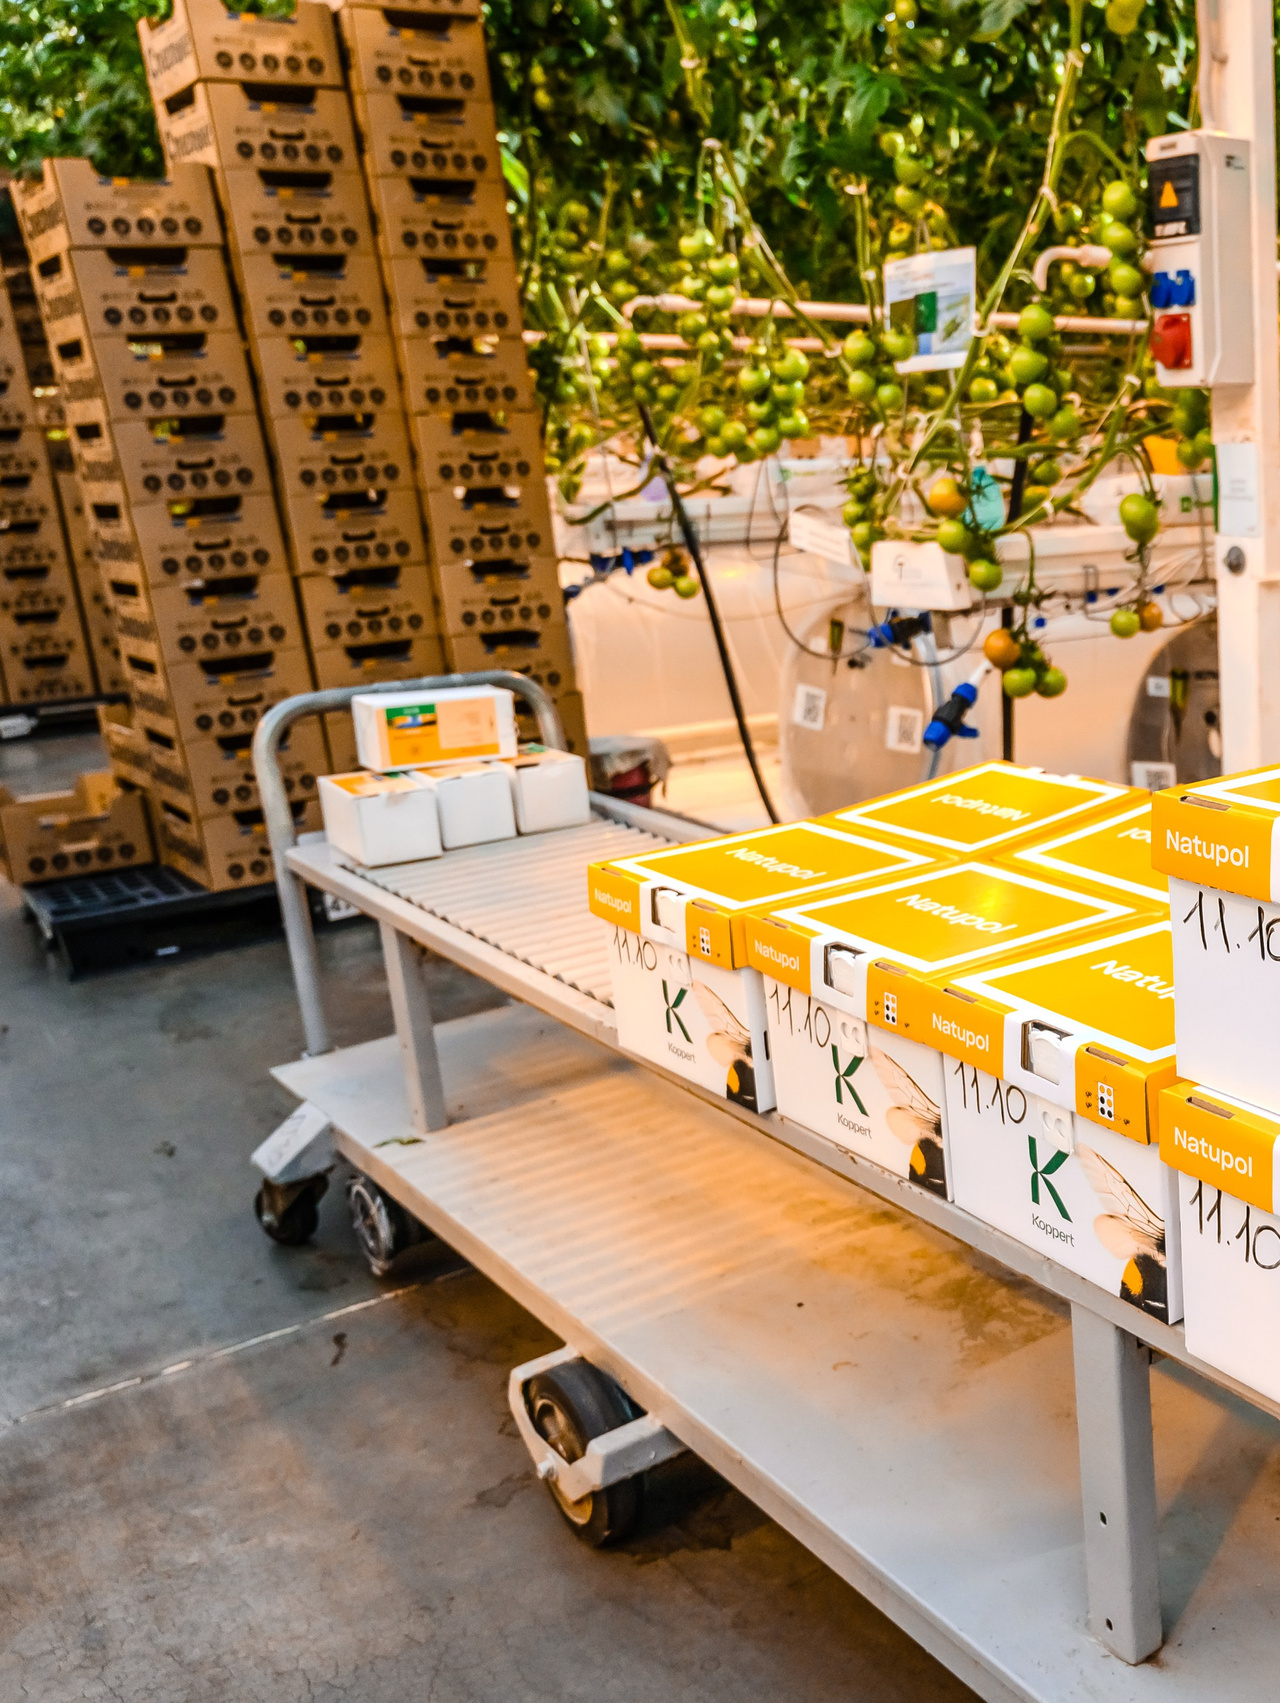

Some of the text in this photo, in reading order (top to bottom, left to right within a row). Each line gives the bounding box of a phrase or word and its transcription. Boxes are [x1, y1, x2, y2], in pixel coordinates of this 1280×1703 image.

[930, 792, 1032, 822] Natupol
[725, 846, 828, 880] Natupol
[1166, 828, 1250, 869] Natupol
[594, 887, 633, 915] Natupol
[896, 893, 1018, 935] Natupol
[613, 925, 659, 972] 11.10
[754, 938, 801, 972] Natupol
[768, 983, 833, 1049] 11.10
[932, 1012, 990, 1053] Natupol
[953, 1062, 1029, 1125] 11.10
[836, 1111, 874, 1140] Koppert
[1174, 1126, 1254, 1178] Natupol
[1031, 1213, 1076, 1248] Koppert
